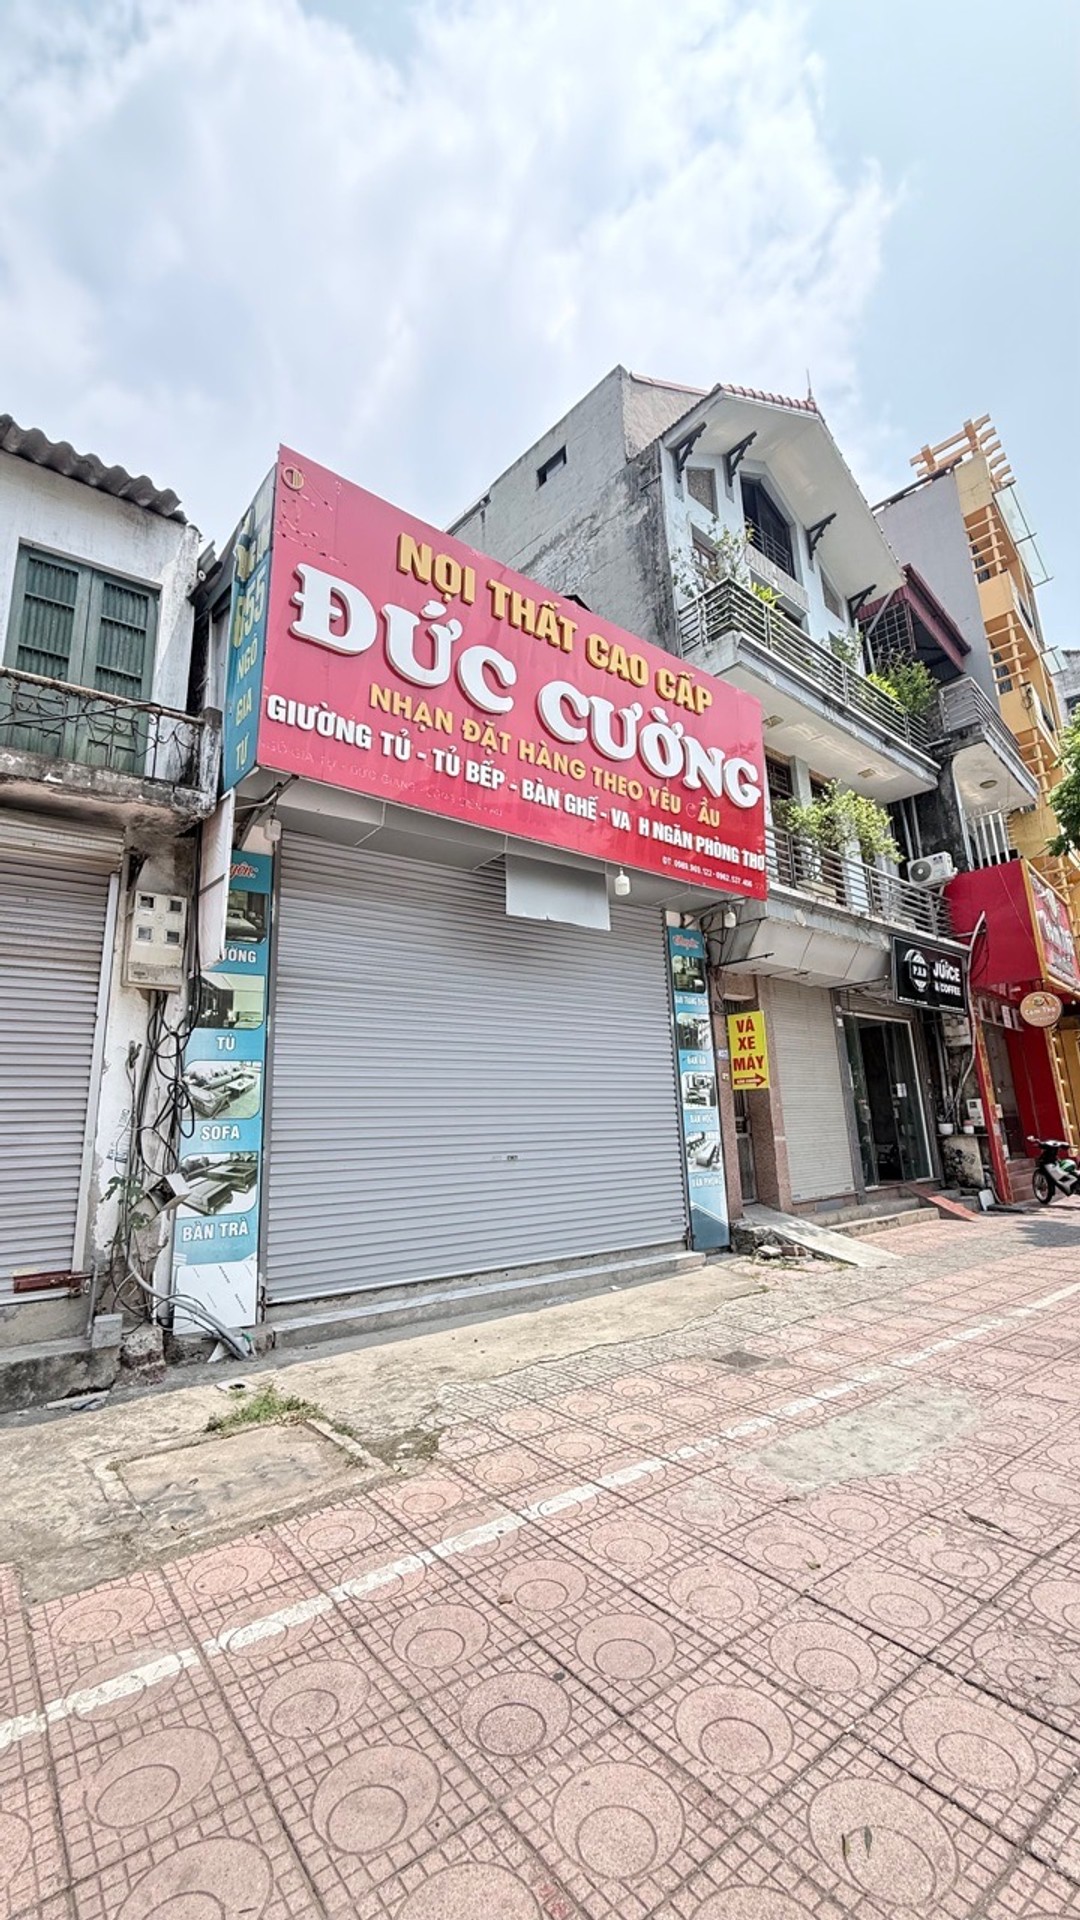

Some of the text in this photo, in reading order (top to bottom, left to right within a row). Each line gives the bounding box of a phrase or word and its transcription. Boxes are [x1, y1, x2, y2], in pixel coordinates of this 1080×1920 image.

[236, 633, 258, 682] NGÔ
[487, 578, 579, 653] THẤT
[585, 633, 650, 688] CAO
[655, 668, 713, 716] CẤP
[289, 562, 761, 809] ĐỨC CƯỜNG
[235, 688, 253, 726] GIA
[235, 732, 249, 771] TỰ
[461, 718, 511, 755] ĐẶT
[518, 733, 586, 780] HÀNG
[592, 765, 643, 801] THEO
[649, 785, 681, 815] YÊU
[266, 694, 372, 749] GIƯỜNG
[380, 728, 411, 761] TỦ
[432, 745, 460, 777] TỦ
[465, 759, 506, 790] BẾP
[521, 777, 560, 810] BÀN
[564, 795, 599, 821] GHẾ
[652, 822, 693, 850] NGĂN
[695, 836, 740, 865] PHÒNG
[940, 983, 961, 996] COFFEE
[736, 1016, 755, 1033] VÁ
[216, 1034, 235, 1051] TỦ
[738, 1036, 756, 1051] XE
[733, 1053, 764, 1071] MÁY
[201, 1126, 240, 1141] SOFA
[182, 1218, 249, 1243] BÀN TRÀ
